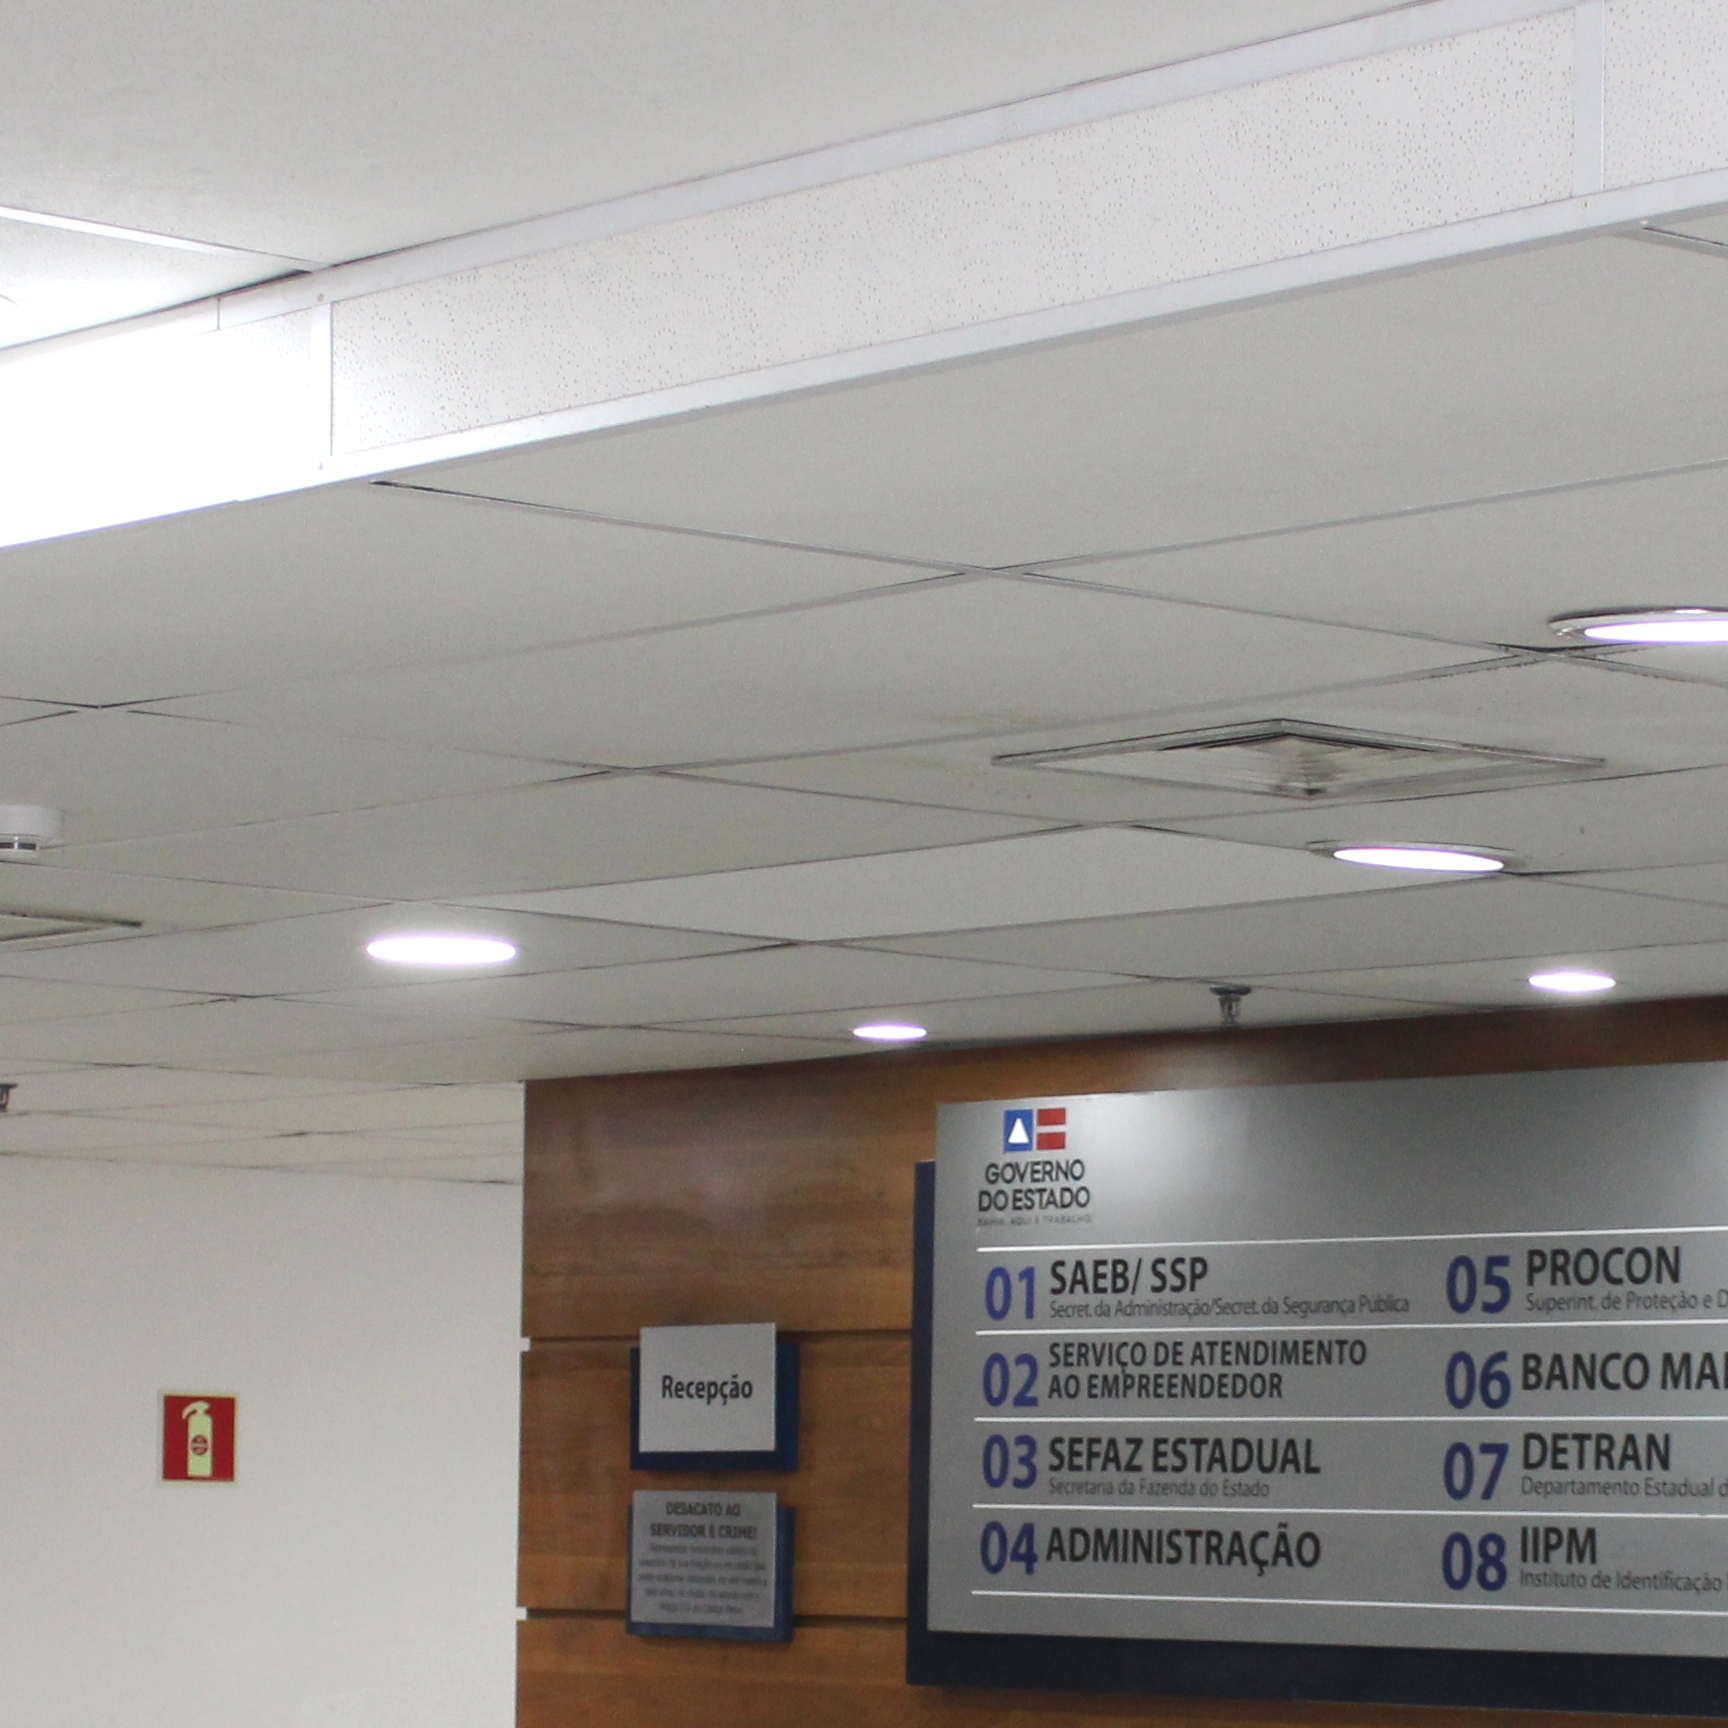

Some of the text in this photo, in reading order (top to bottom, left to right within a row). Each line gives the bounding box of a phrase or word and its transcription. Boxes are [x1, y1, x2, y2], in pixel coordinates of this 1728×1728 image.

[985, 1159, 1084, 1184] GOVERNO
[978, 1186, 1090, 1212] DO ESTADO
[1050, 1257, 1208, 1295] SAEB/ SSP
[1446, 1255, 1511, 1315] 05
[1527, 1246, 1680, 1286] PROCON
[985, 1266, 1036, 1320] 01
[1050, 1300, 1092, 1318] Secret.
[1095, 1299, 1111, 1317] da
[1262, 1297, 1280, 1316] da
[1283, 1297, 1356, 1318] Segurança
[1359, 1295, 1410, 1314] Pública
[1526, 1292, 1595, 1315] Superint.
[1600, 1290, 1621, 1310] de
[1626, 1289, 1698, 1312] Proteção
[1702, 1293, 1713, 1308] e
[1048, 1339, 1367, 1374] SERVIÇO DE ATENDIMENTO
[1522, 1352, 1649, 1390] BANCO
[662, 1374, 753, 1405] Recepção
[982, 1352, 1039, 1407] 02
[1047, 1372, 1282, 1399] AO EMPREENDEDOR
[1445, 1351, 1511, 1409] 06
[982, 1434, 1038, 1489] 03
[1048, 1437, 1321, 1475] SEFAZ ESTADUAL
[1522, 1433, 1670, 1471] DETRAN
[1049, 1478, 1270, 1498] Secretaria da Fazenda do Estado
[1443, 1442, 1509, 1501] 07
[1521, 1476, 1639, 1498] Departamento
[1644, 1476, 1715, 1497] Estadual
[981, 1521, 1038, 1576] 04
[1046, 1522, 1321, 1576] ADMINISTRAÇÃO
[1441, 1532, 1508, 1593] 08
[1520, 1526, 1597, 1564] IIPM
[1520, 1569, 1587, 1589] Instituto
[1591, 1570, 1612, 1590] de
[1616, 1570, 1723, 1596] Identificação
